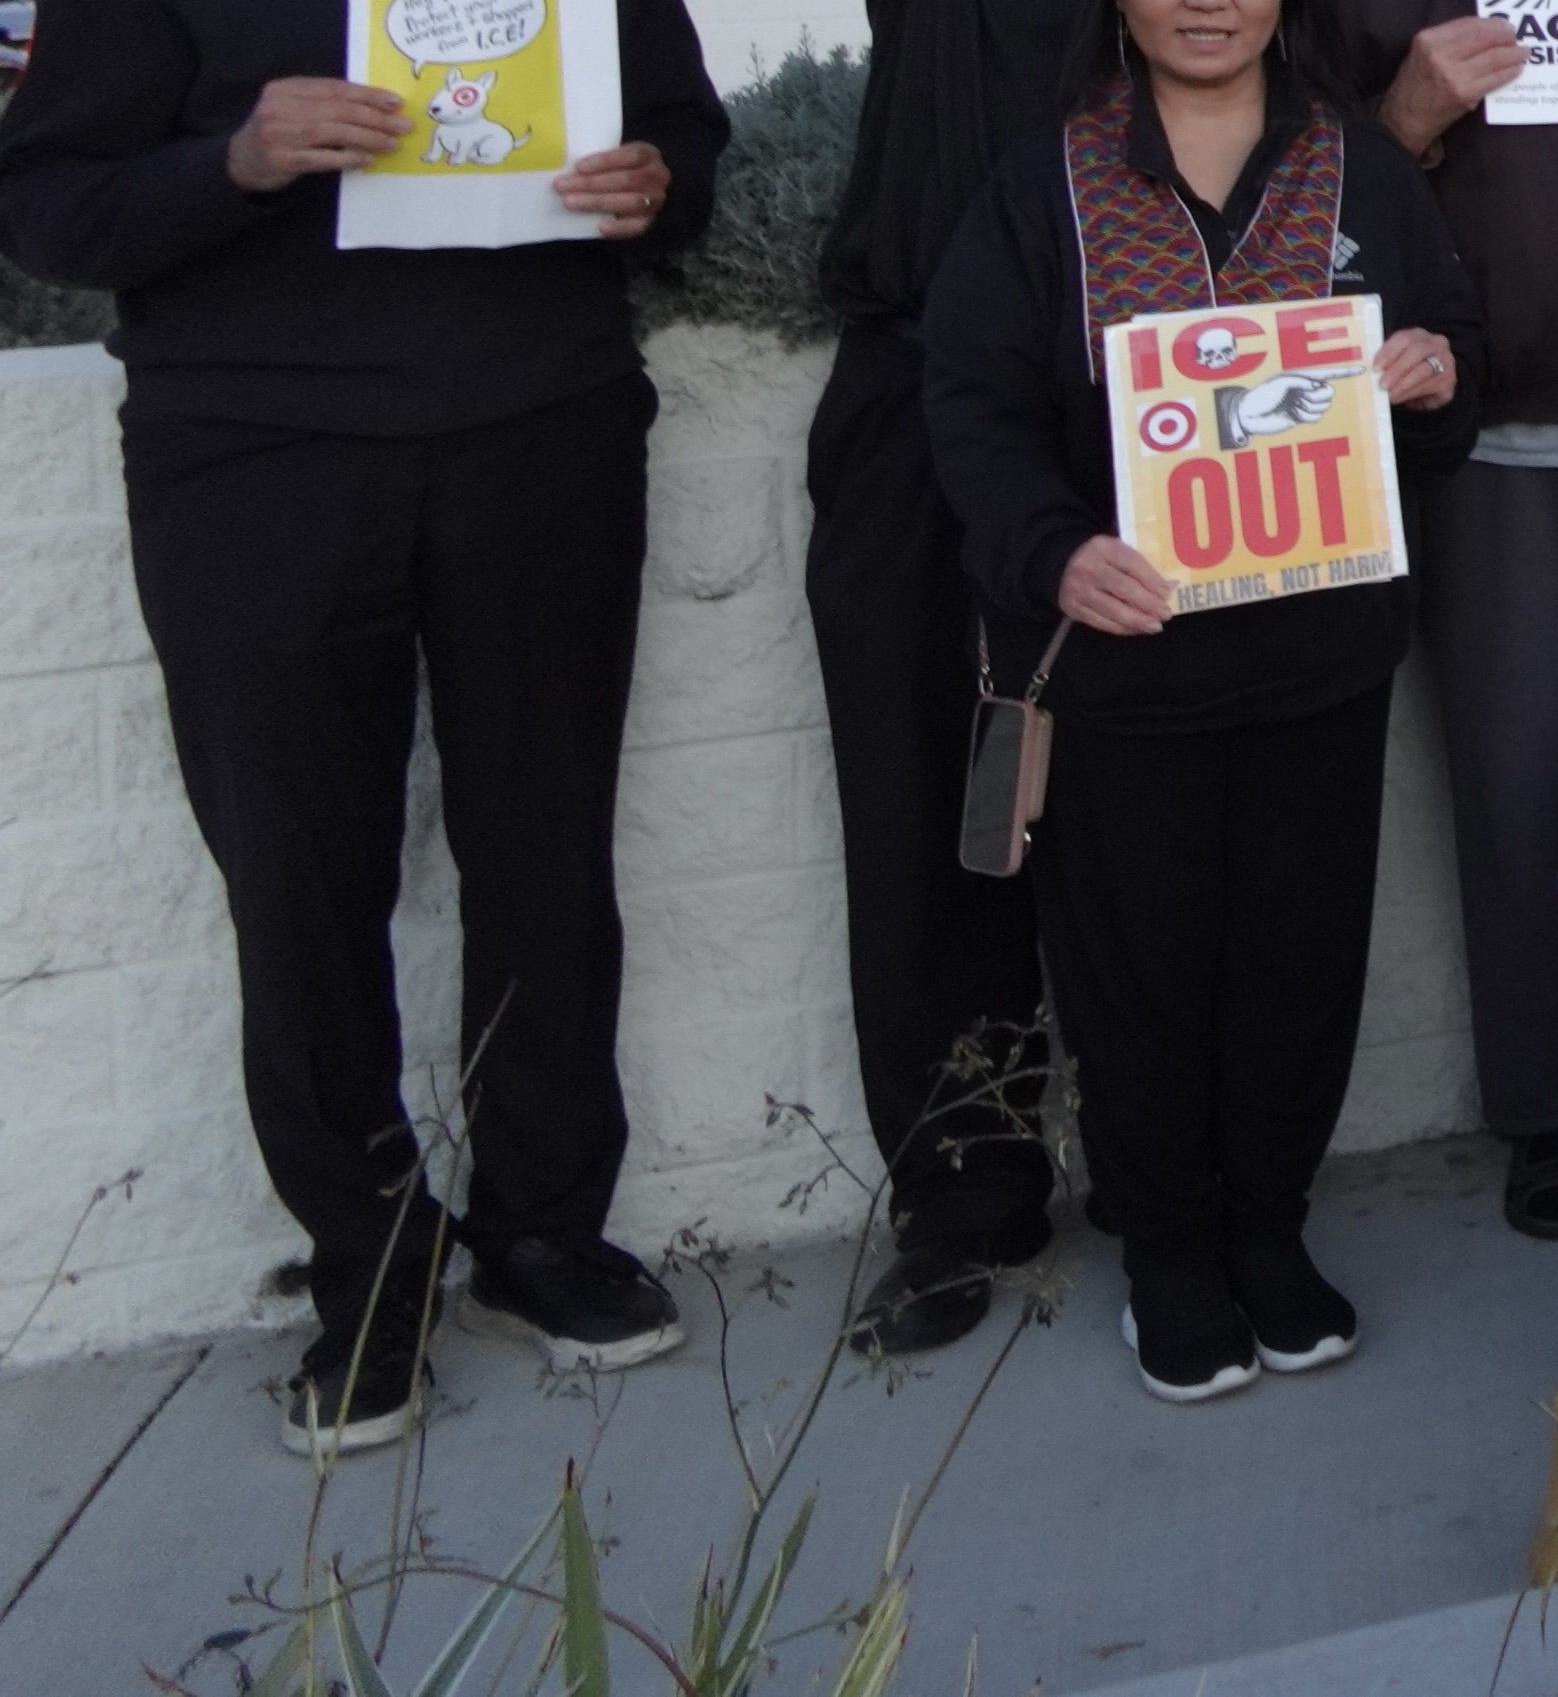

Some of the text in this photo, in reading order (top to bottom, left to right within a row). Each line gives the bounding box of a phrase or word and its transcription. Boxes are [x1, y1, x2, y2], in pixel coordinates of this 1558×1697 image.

[1128, 302, 1362, 393] ICE
[1168, 436, 1350, 570] OUT
[1177, 551, 1394, 612] HEALING, NOT HARM
